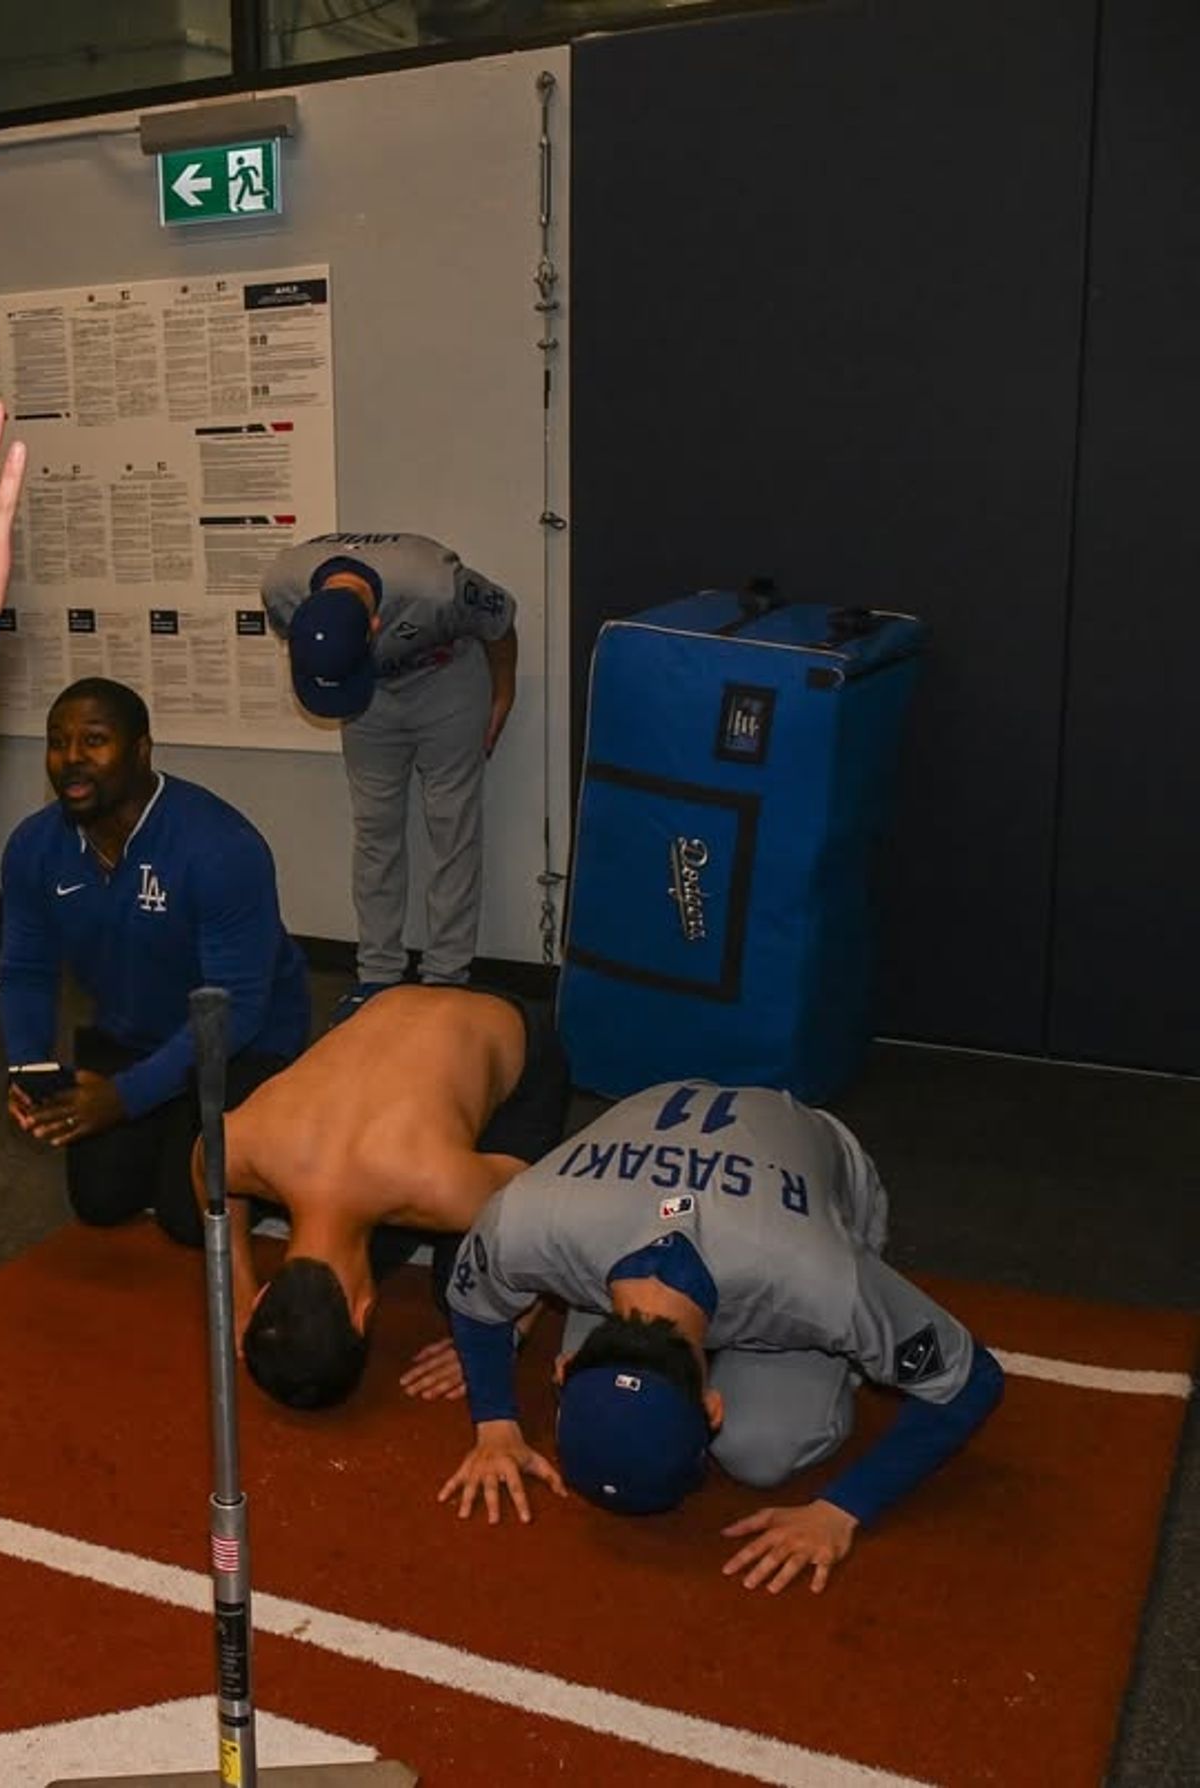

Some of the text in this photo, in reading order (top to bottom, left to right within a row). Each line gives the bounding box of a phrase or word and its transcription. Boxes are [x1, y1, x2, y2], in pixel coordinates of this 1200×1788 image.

[138, 863, 168, 912] LA
[655, 1087, 738, 1133] 11
[557, 1142, 810, 1216] R. SASAKI
